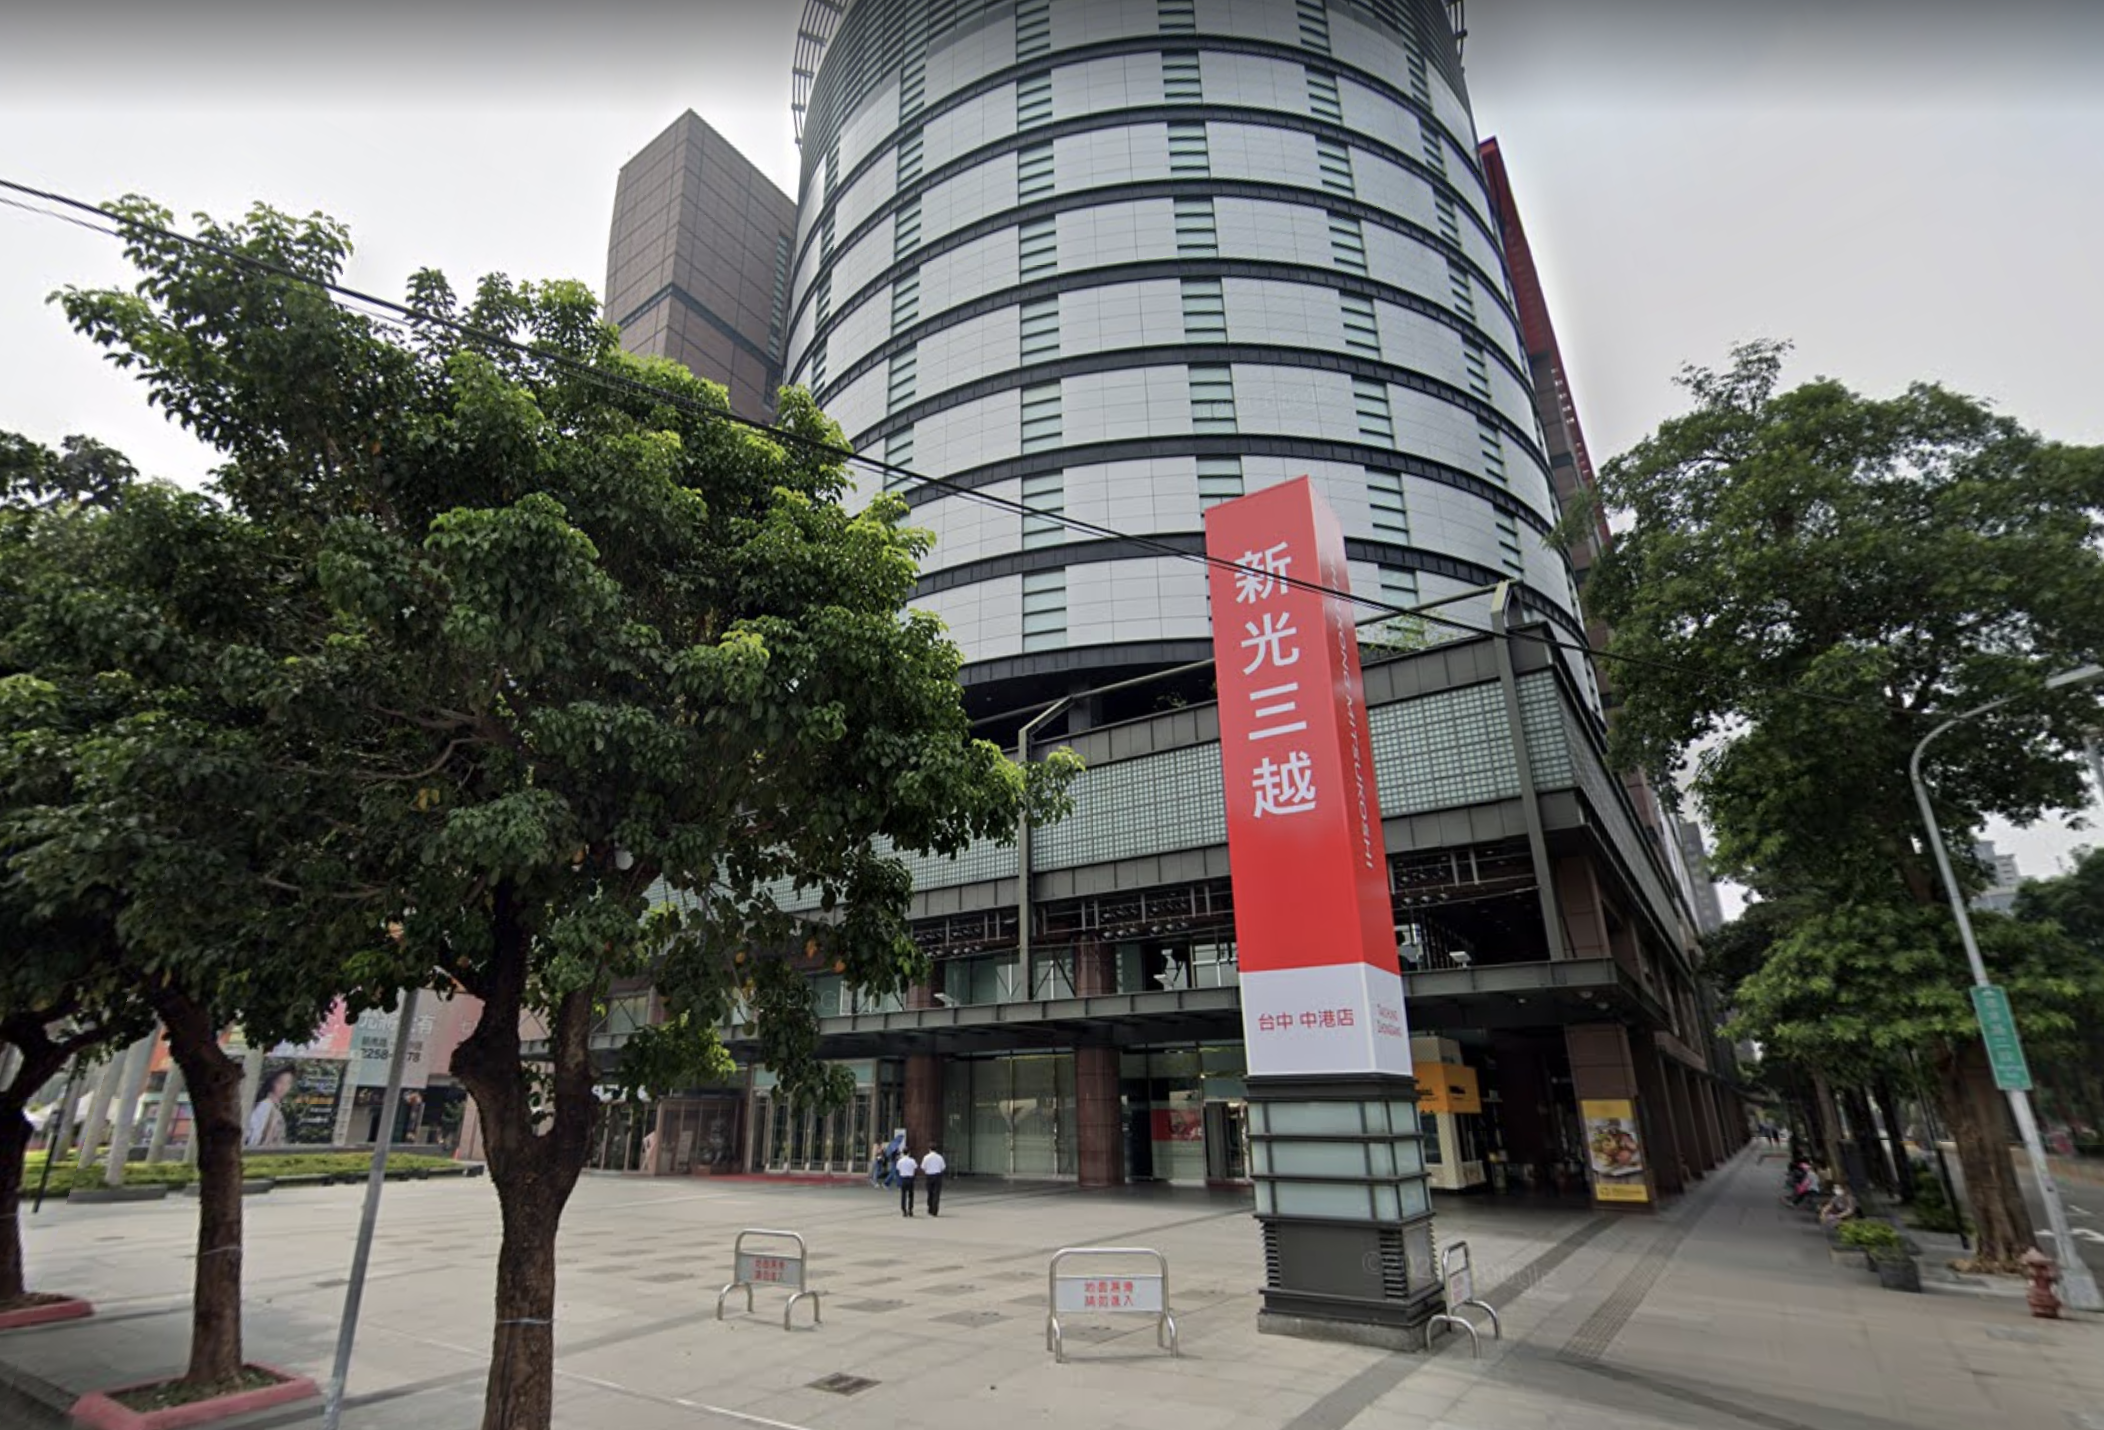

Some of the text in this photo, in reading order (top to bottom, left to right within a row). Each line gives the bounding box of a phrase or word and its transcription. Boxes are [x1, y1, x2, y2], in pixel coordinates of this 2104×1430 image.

[1234, 541, 1316, 818] 新光三越
[1346, 695, 1373, 869] MITSUKOSHI
[1258, 1012, 1293, 1031] 台中
[1299, 1009, 1355, 1028] 中港店
